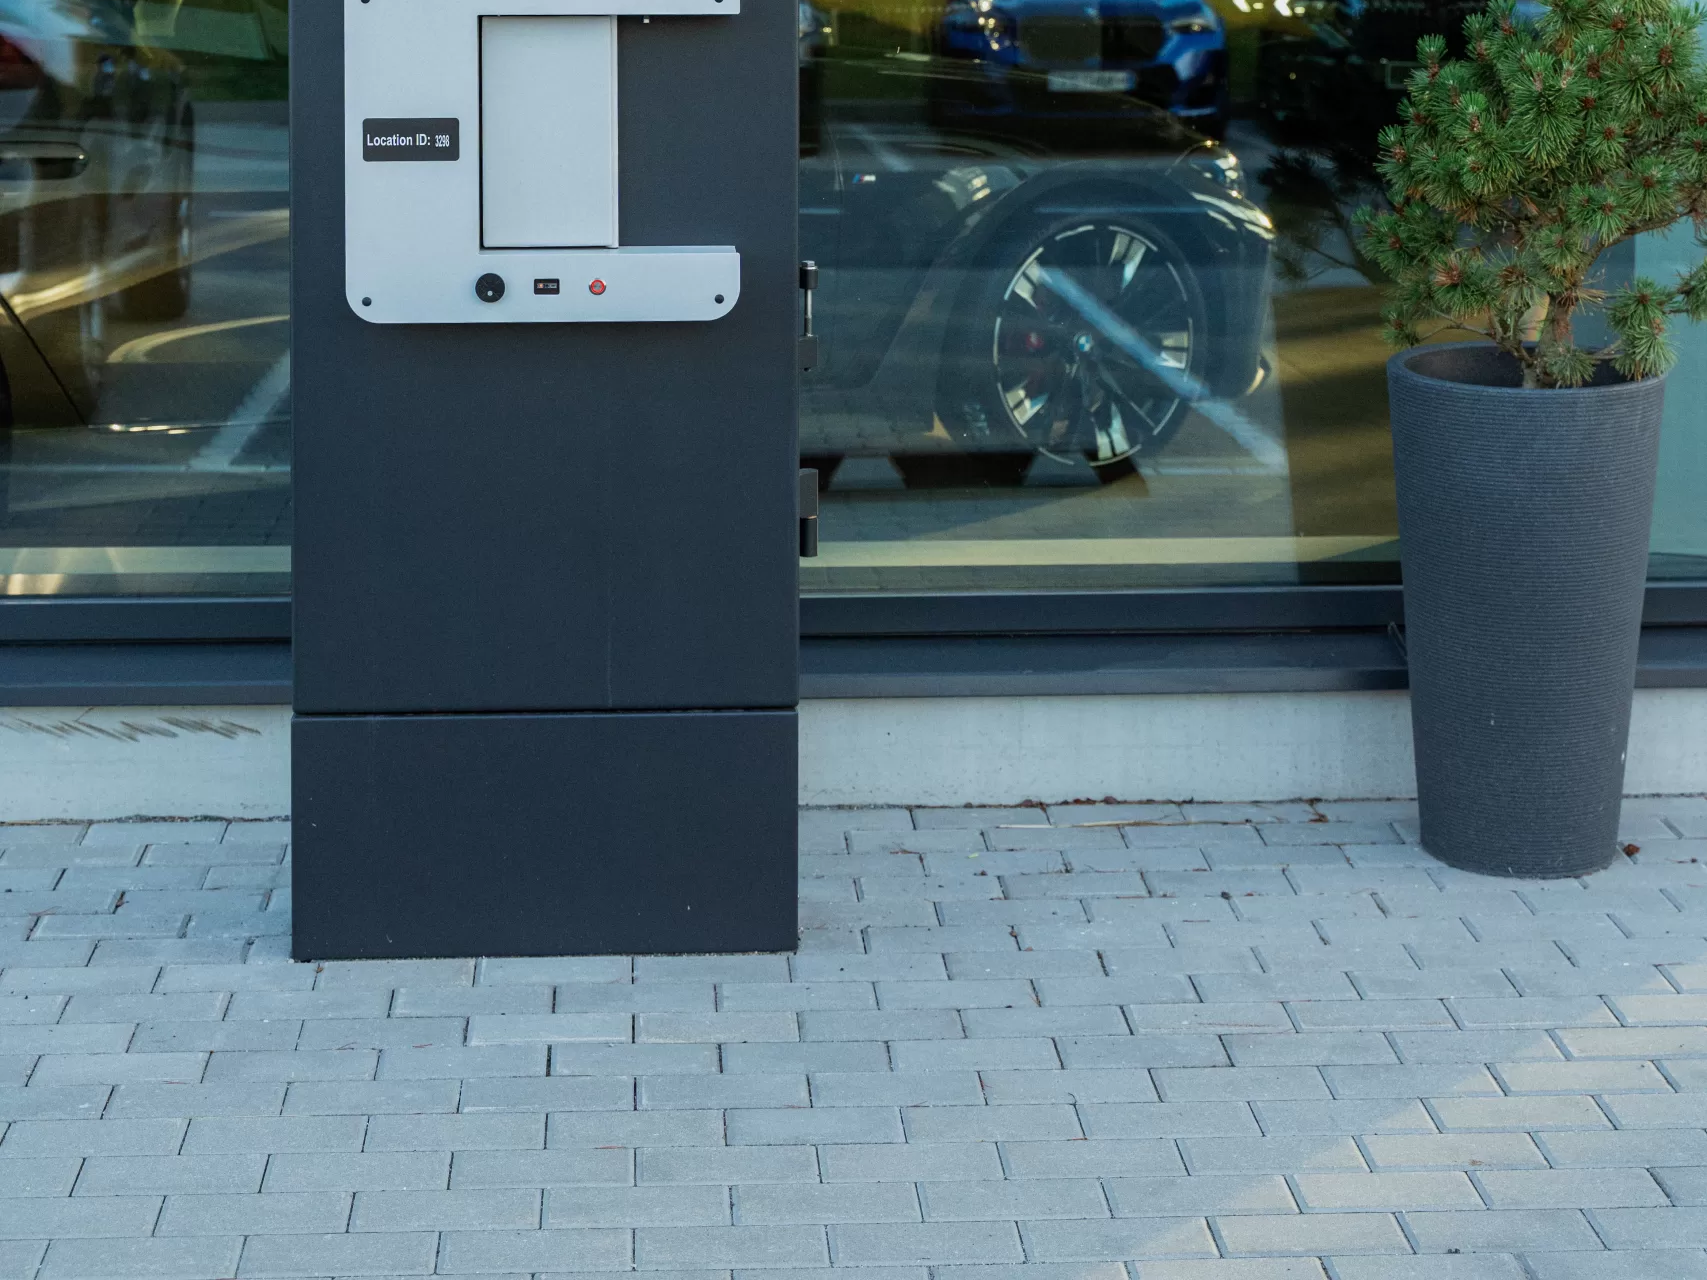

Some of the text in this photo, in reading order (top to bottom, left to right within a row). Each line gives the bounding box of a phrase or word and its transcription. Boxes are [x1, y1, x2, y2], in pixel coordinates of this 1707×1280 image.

[367, 133, 450, 147] Location ID: 3298
